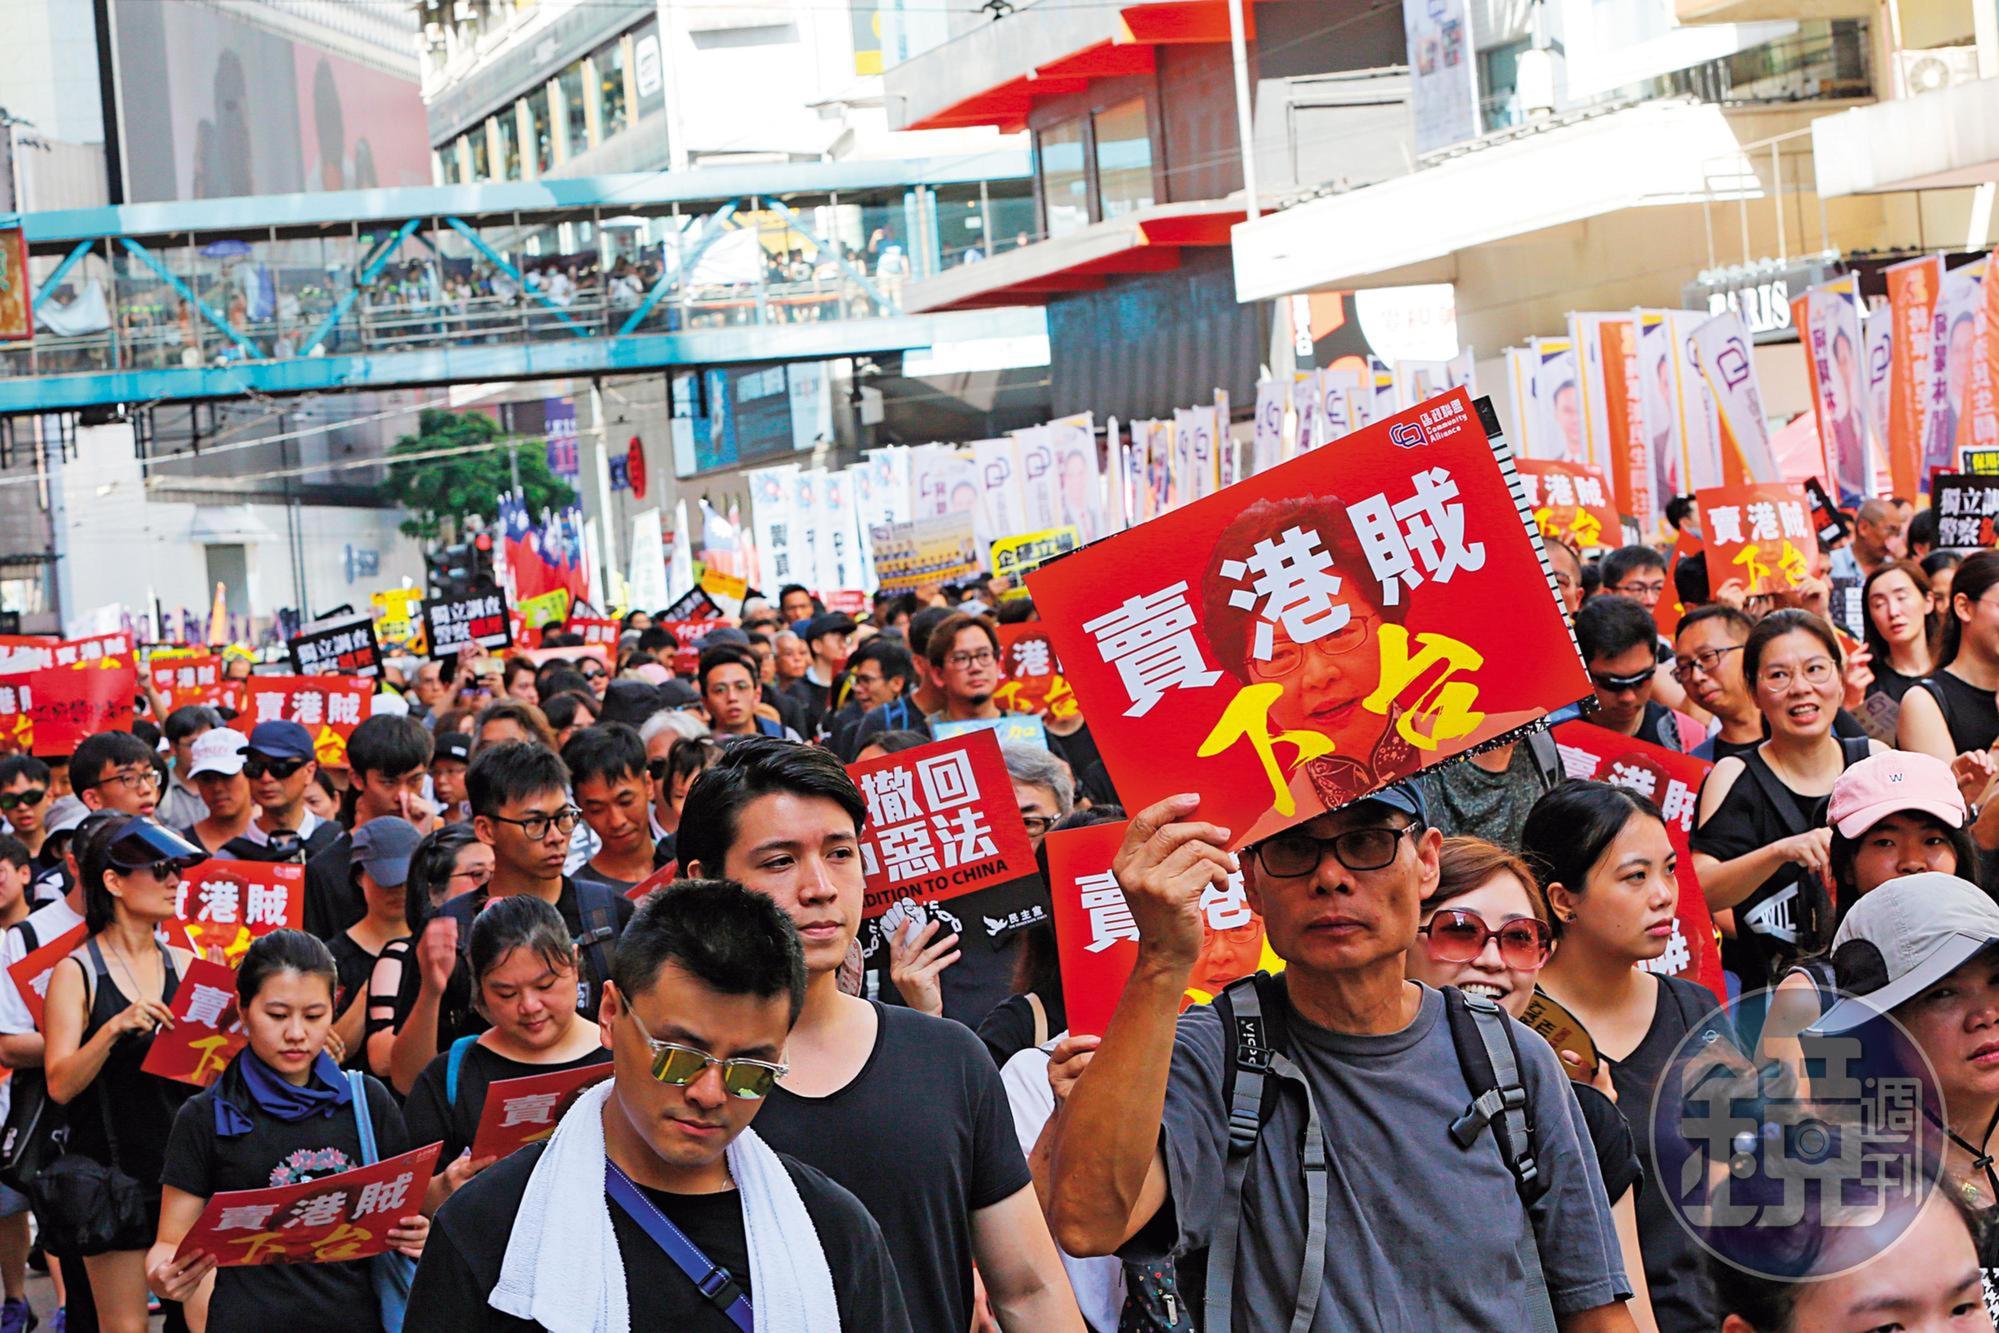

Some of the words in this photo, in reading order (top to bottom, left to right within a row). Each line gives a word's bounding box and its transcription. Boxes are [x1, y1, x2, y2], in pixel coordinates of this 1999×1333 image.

[1426, 414, 1468, 436] Community
[1430, 425, 1462, 443] Alliance
[1707, 501, 1808, 546] 賣港賊
[1732, 540, 1808, 592] 下台
[1083, 466, 1486, 717] 賣港賊
[256, 691, 361, 725] 賣港賊
[1197, 622, 1485, 817] 下台
[861, 749, 981, 827] 撤回
[1888, 773, 1903, 783] W
[863, 883, 923, 909] DITION
[924, 875, 949, 894] TO
[952, 859, 1008, 886] CHINA
[1008, 905, 1043, 925] 民主黨
[211, 1172, 413, 1231] 賣港賊
[228, 1223, 373, 1263] 下台
